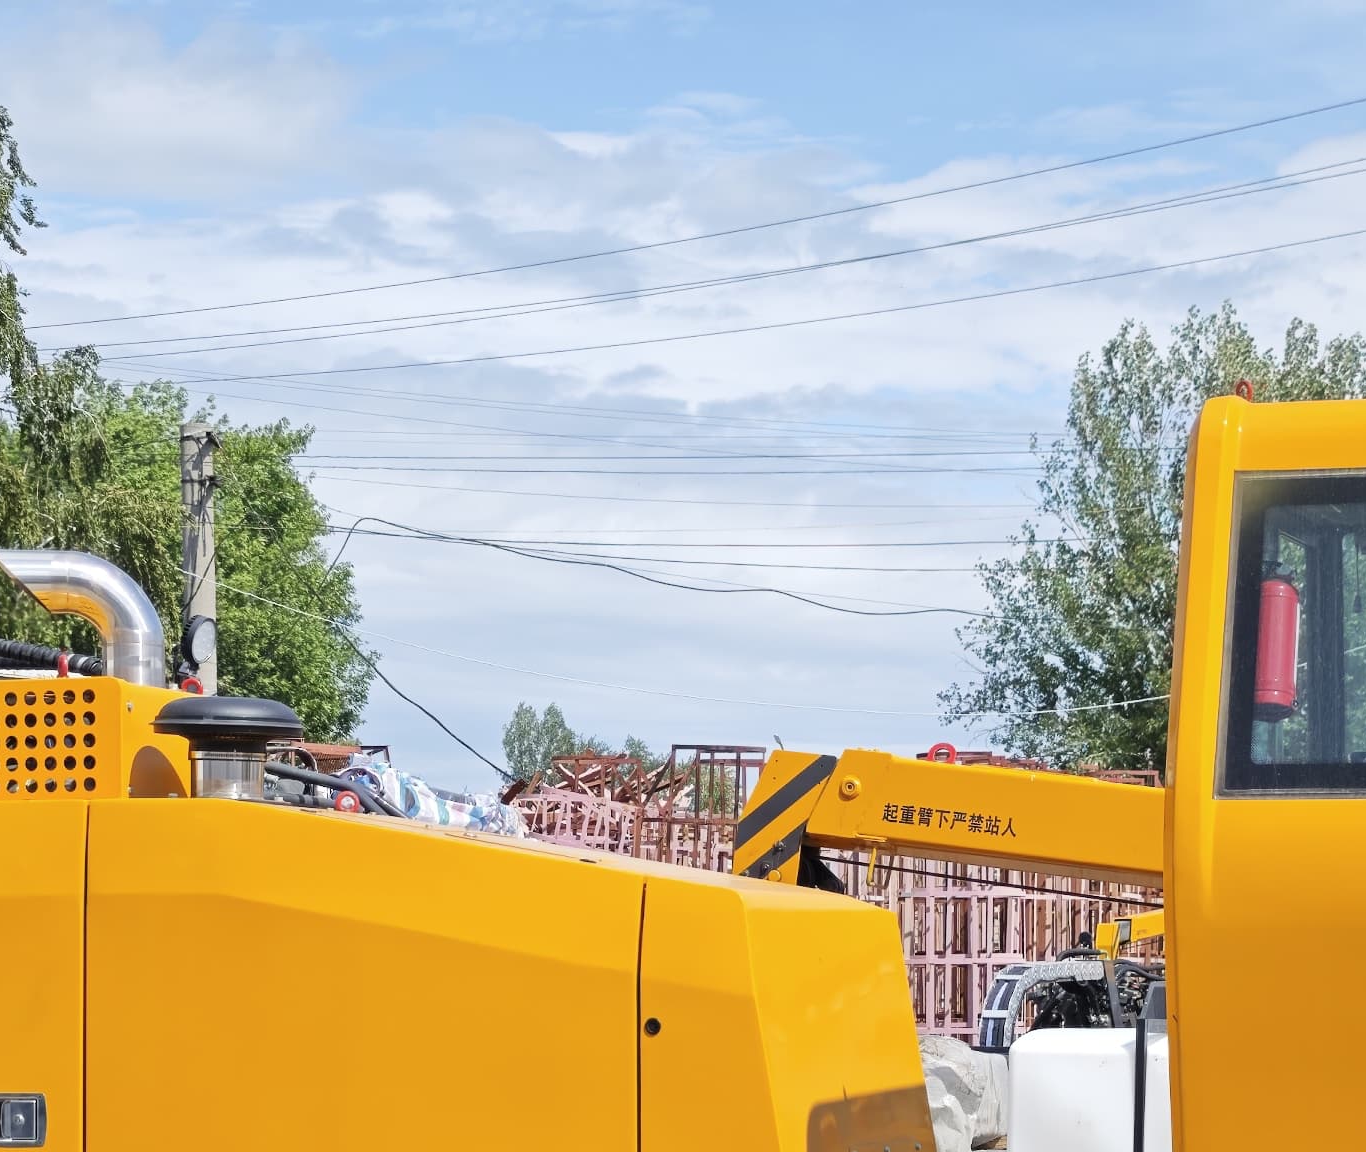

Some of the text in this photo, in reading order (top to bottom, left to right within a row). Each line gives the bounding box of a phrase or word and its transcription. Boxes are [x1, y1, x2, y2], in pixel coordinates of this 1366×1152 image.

[882, 802, 1017, 838] 起重臂下严禁站人
